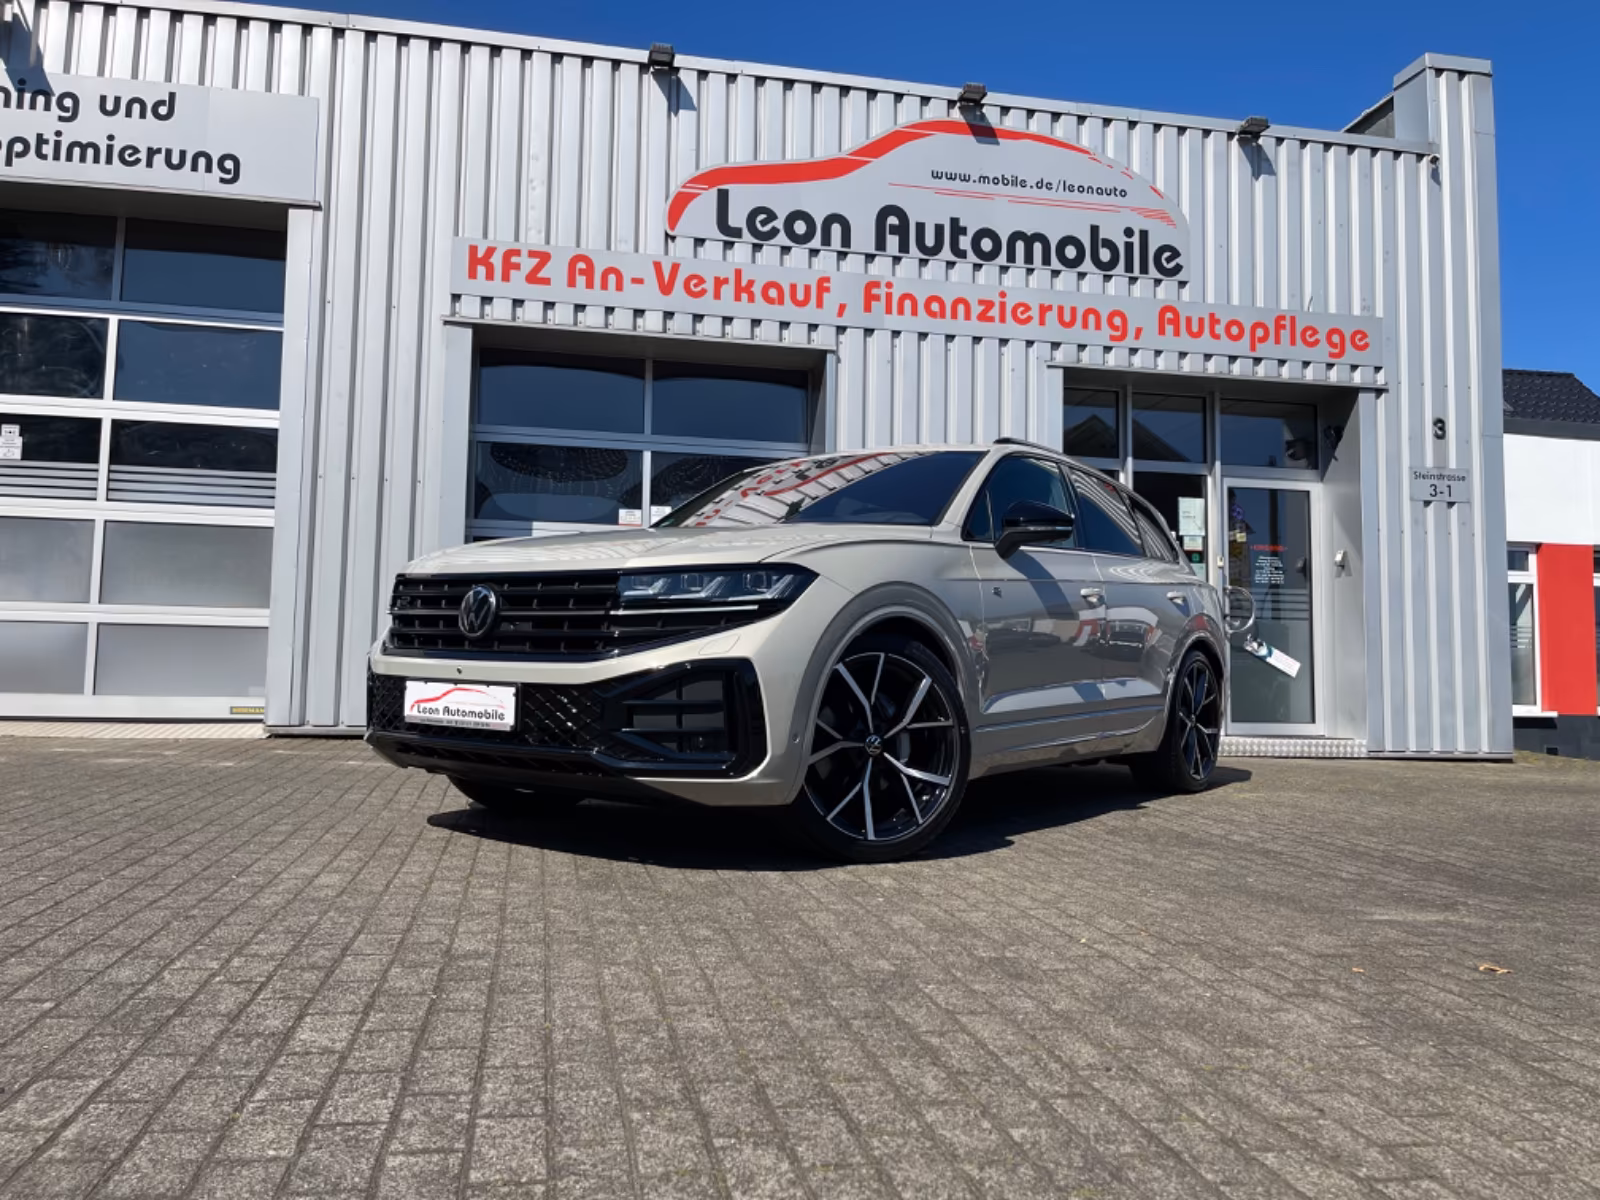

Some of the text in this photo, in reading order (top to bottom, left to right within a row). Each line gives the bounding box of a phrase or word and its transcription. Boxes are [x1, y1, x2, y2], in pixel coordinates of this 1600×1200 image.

[99, 91, 177, 121] und
[0, 129, 241, 184] ptimierung
[931, 169, 1128, 198] www.mobile.de/leonauto
[715, 188, 1184, 279] Leon Automobile
[862, 280, 1144, 343] Finanzierung,
[1157, 304, 1371, 359] Autopflege
[1432, 417, 1447, 440] 3
[1413, 470, 1467, 482] Steinstrasse
[1429, 483, 1453, 498] 3-1
[416, 703, 506, 721] Leon Automobile
